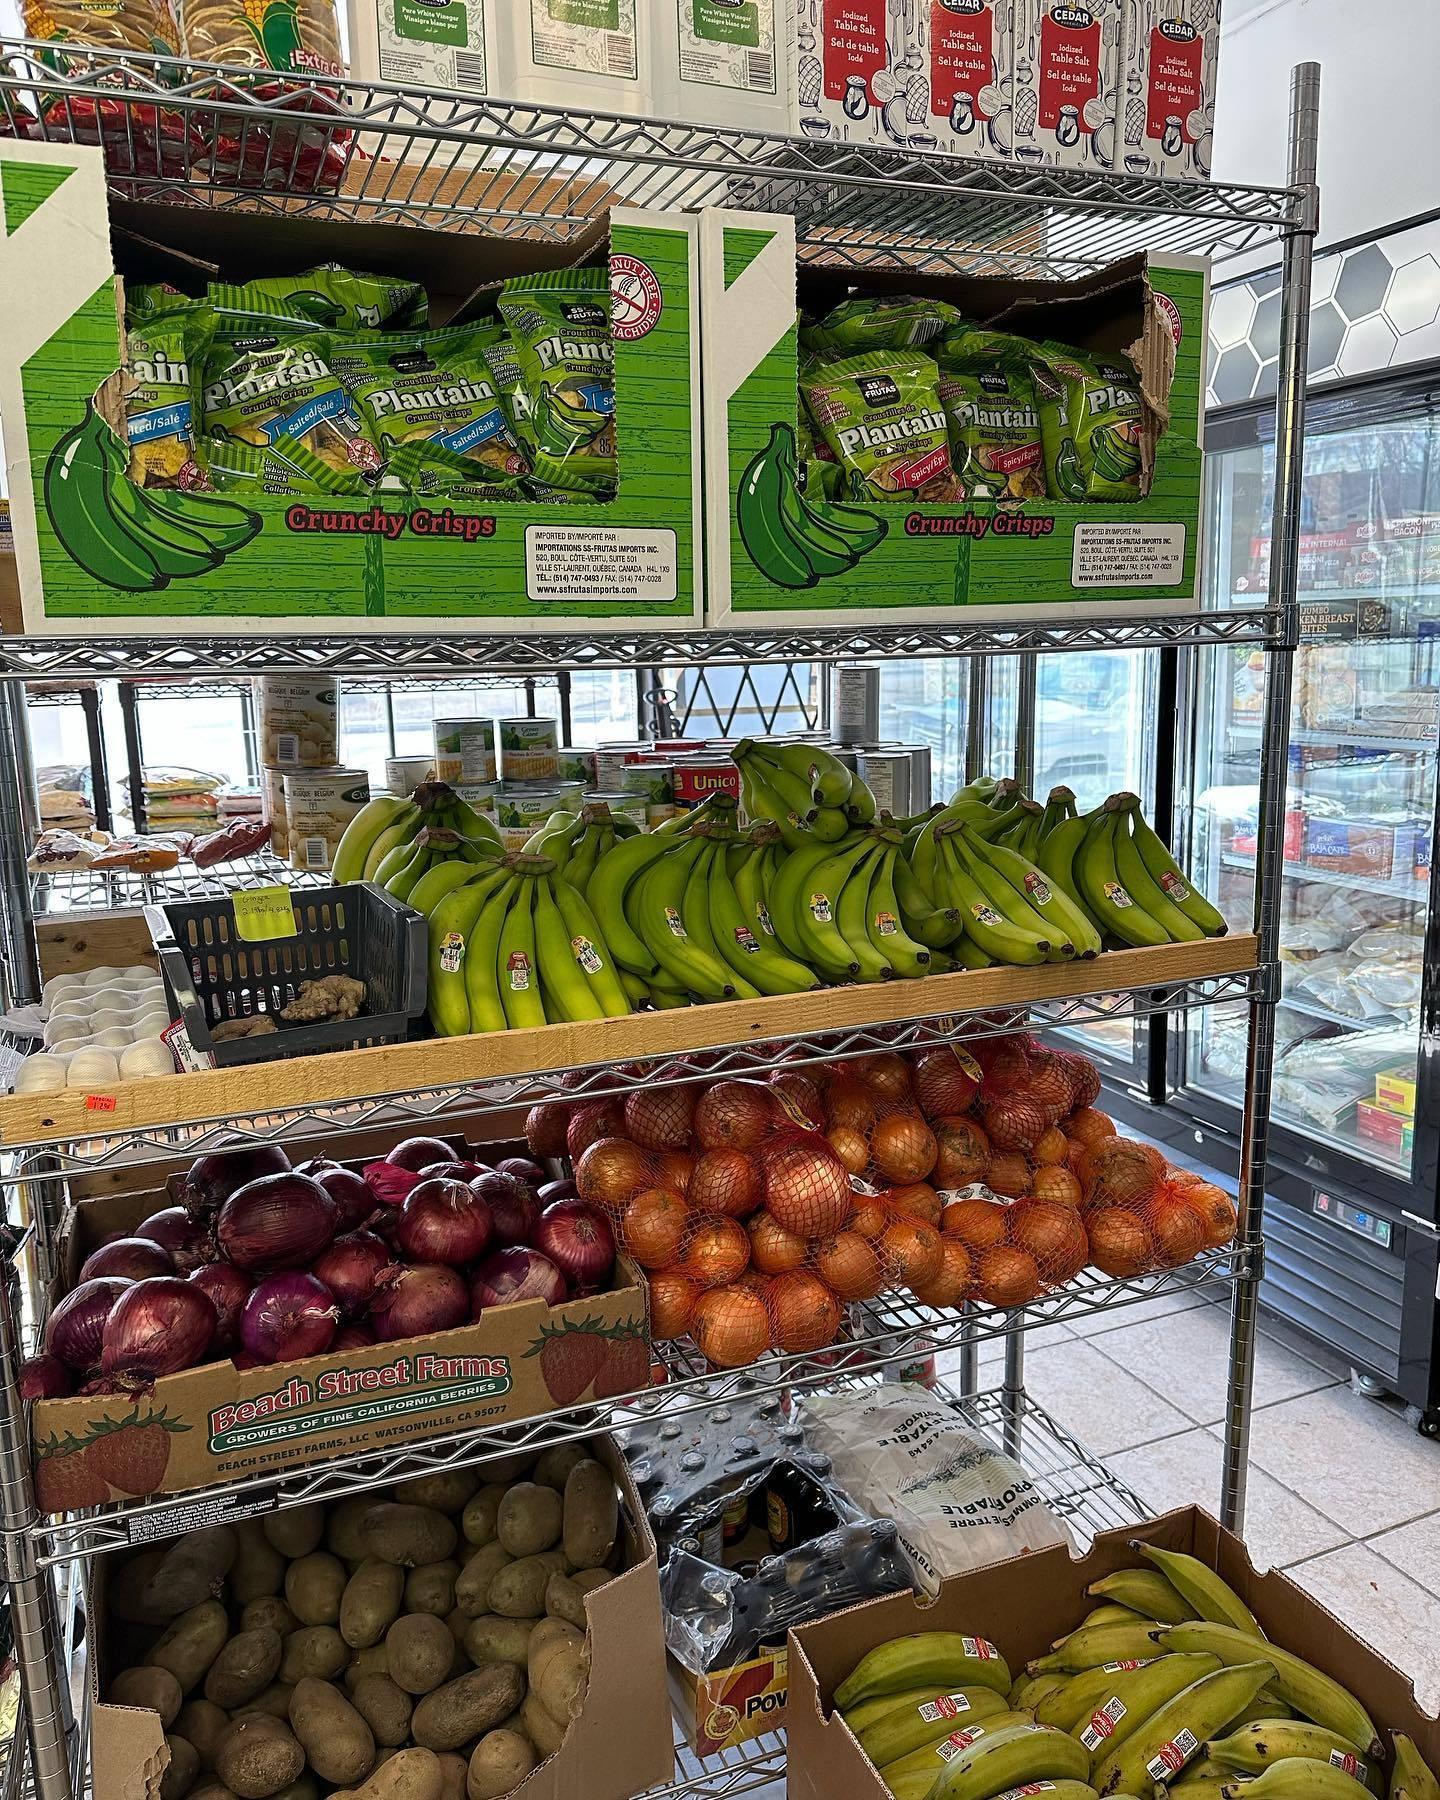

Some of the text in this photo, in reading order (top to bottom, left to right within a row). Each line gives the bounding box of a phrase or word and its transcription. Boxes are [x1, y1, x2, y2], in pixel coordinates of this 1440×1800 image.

[944, 0, 980, 10] CEDAR
[402, 6, 459, 22] Pure White Vinegar
[714, 9, 730, 18] White
[731, 12, 752, 22] Vinegar
[842, 10, 868, 22] Iodized
[1054, 10, 1089, 24] CEDAR
[834, 20, 876, 35] Table Salt
[1162, 23, 1193, 38] CEDAR
[949, 30, 974, 40] Iodized
[831, 38, 879, 54] Sel de table
[941, 39, 982, 52] Table Salt
[1059, 44, 1083, 54] Iodized
[848, 53, 864, 62] Iodé
[938, 56, 985, 70] Sel de table
[1051, 53, 1090, 66] Table Salt
[1166, 56, 1187, 66] Iodized
[955, 71, 970, 79] Iodé
[1047, 70, 1092, 84] Sel de table
[1159, 65, 1193, 78] Table Salt
[1062, 84, 1077, 92] Iodé
[1155, 81, 1194, 95] Sel de table
[1168, 95, 1181, 104] Iodé
[639, 270, 658, 300] FREE
[566, 311, 603, 320] FRUTAS
[534, 336, 614, 370] Plant
[565, 363, 602, 375] Crunchy
[204, 352, 331, 412] Plantain
[393, 372, 454, 388] Croustilles de
[980, 377, 1006, 385] FRUTAS
[365, 377, 496, 421] Plantain
[864, 385, 896, 399] FRUTAS
[240, 385, 314, 416] Crunchy Crisps
[288, 400, 335, 434] Salted/Salé
[406, 408, 472, 425] Crunchy Crisps
[451, 419, 495, 450] Salted/Salé
[837, 408, 947, 459] Plantain
[907, 437, 932, 449] Crisps
[910, 454, 946, 482] Spicy/Épi
[287, 506, 496, 542] Crunchy Crisps
[906, 513, 1054, 538] Crunchy Crisps
[1394, 526, 1422, 536] BACON
[535, 532, 566, 540] IMPORTED
[536, 544, 582, 552] IMPORTATIONS
[1078, 573, 1153, 581] www.ssfrutasimports.com
[536, 586, 637, 595] www.ssfrutasimports.com
[1302, 606, 1329, 614] JUMBO
[1319, 614, 1355, 623] BREAST
[1301, 624, 1328, 633] BITES
[693, 775, 736, 790] Unico
[211, 1355, 508, 1437] Beach Street Farms
[226, 1383, 497, 1444] GROWERS OF FINE CALIFORNIA BERRIES
[893, 1411, 942, 1434] POTATOES
[217, 1405, 507, 1472] BEACH STREET FARMS, LLC WATSONVILLE, CA 95077
[909, 1432, 940, 1458] 4.54 kg
[949, 1516, 992, 1528] TERRE
